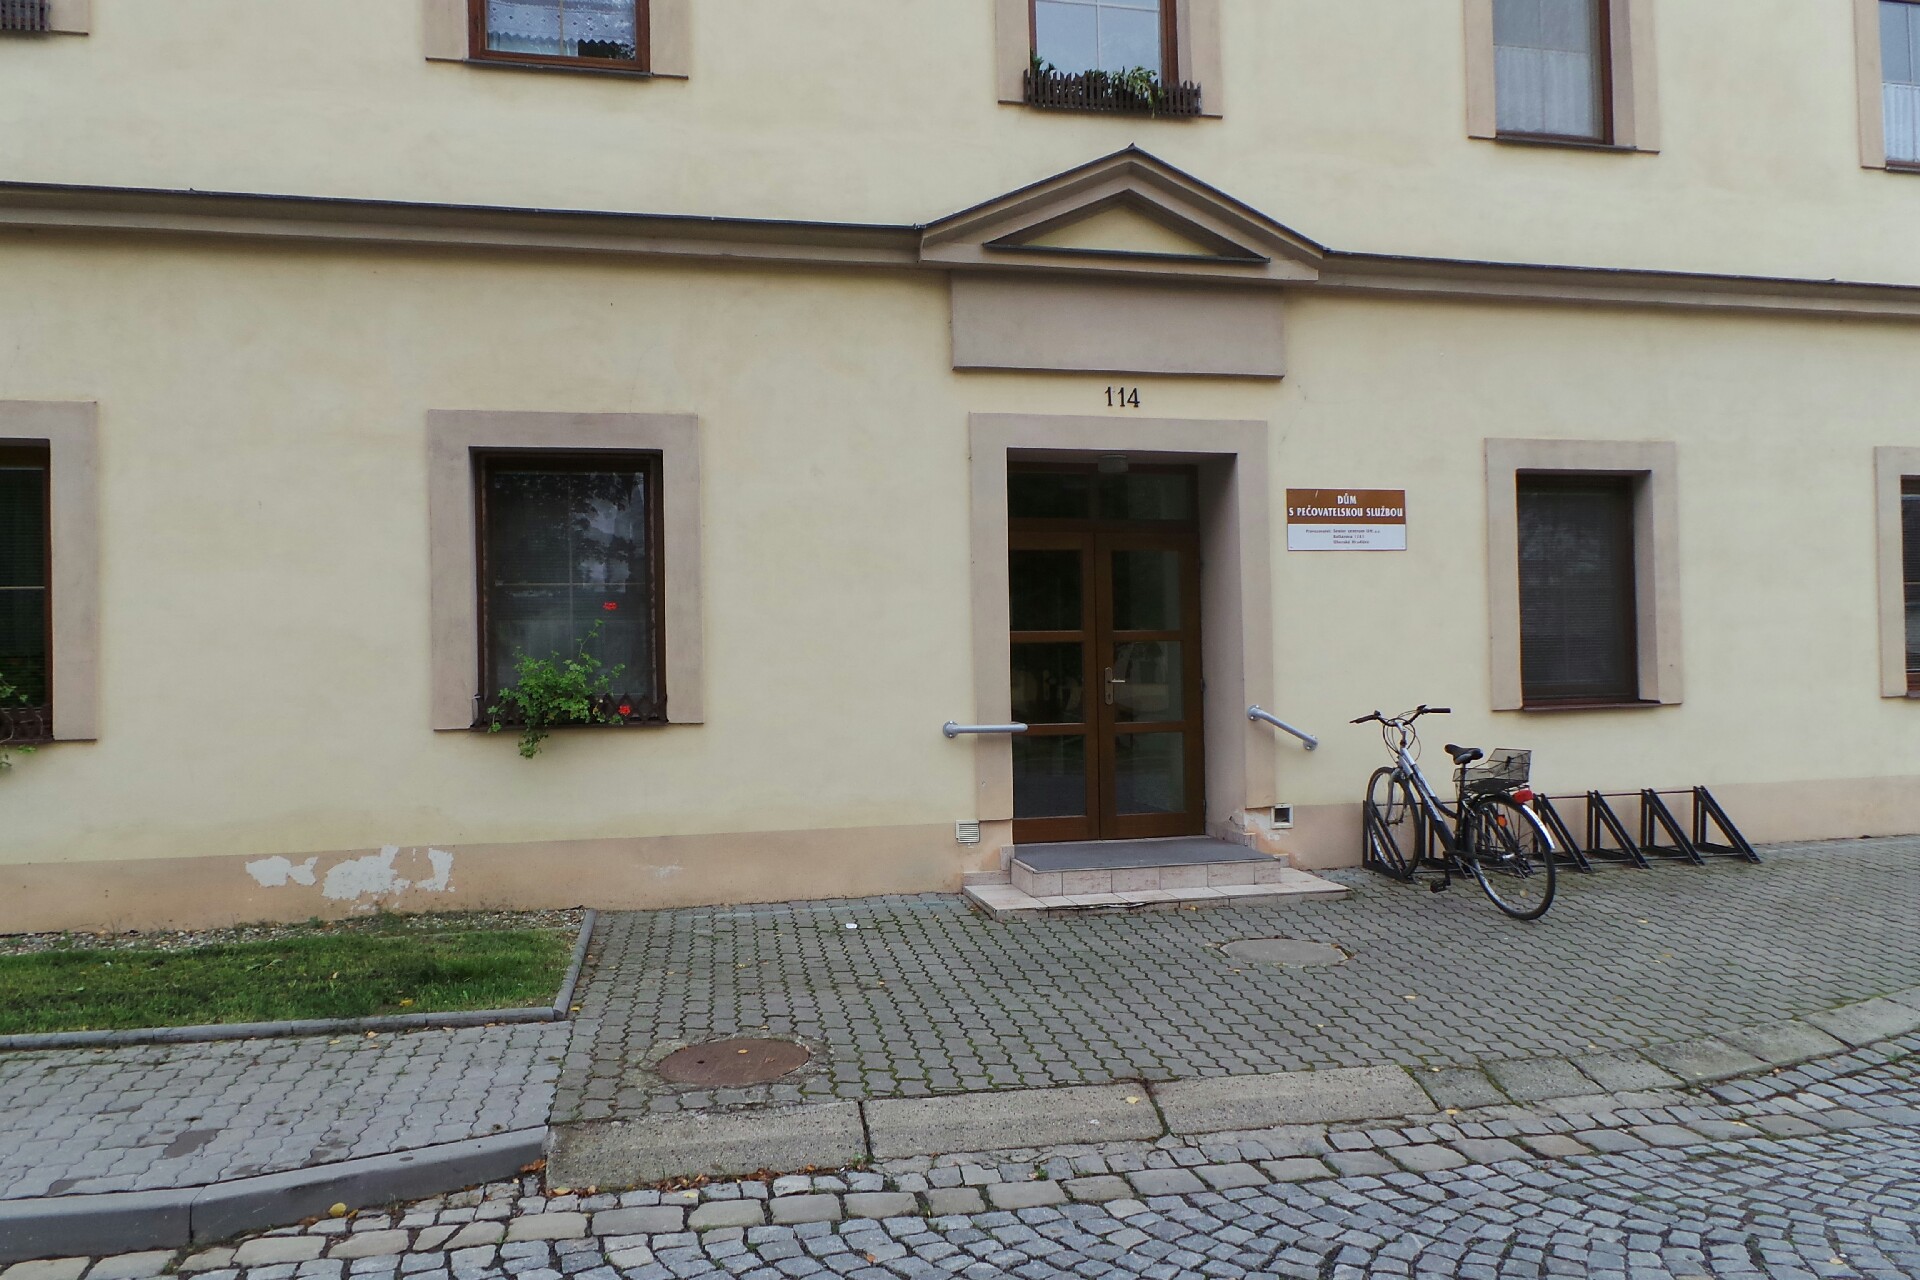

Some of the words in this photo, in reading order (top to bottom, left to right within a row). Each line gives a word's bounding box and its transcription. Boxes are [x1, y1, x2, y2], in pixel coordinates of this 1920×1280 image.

[1104, 386, 1141, 408] 114
[1337, 493, 1357, 505] DŮM
[1289, 507, 1294, 516] S
[1297, 505, 1363, 516] PEČOVATELSKOU
[1366, 506, 1403, 517] SLUŽBOU
